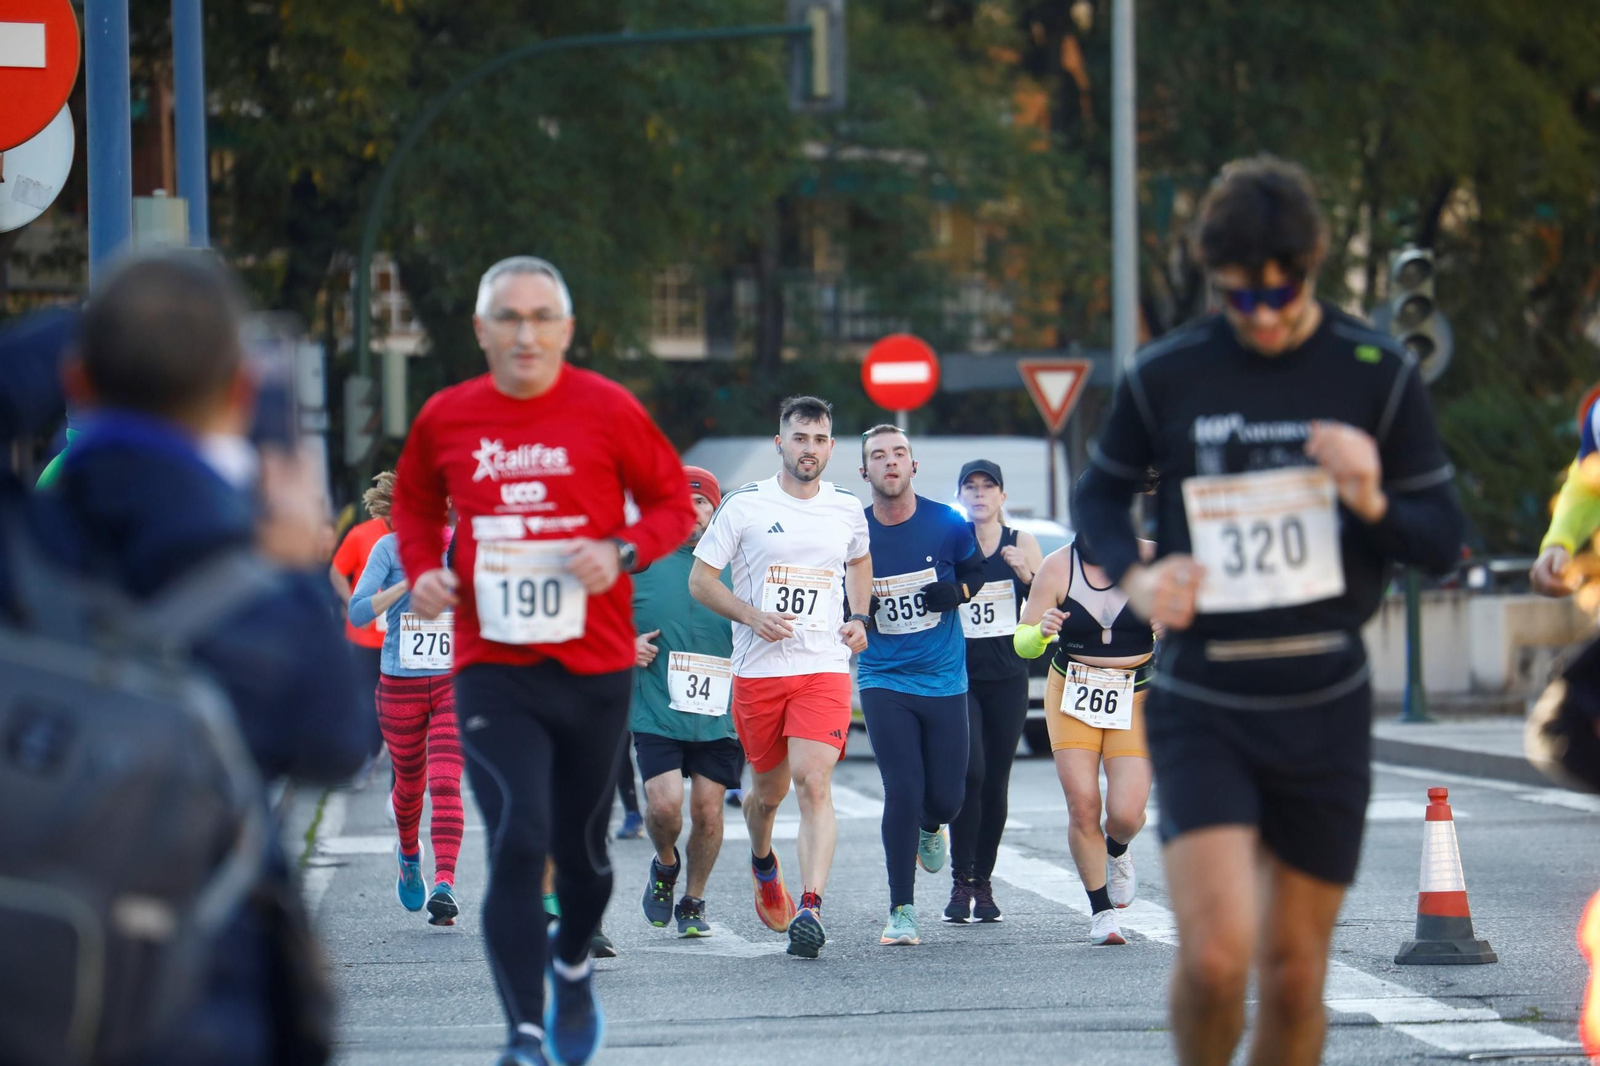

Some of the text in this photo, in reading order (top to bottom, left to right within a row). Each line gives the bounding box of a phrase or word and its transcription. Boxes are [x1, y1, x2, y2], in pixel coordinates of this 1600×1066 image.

[1220, 514, 1308, 578] 320
[767, 565, 789, 585] XLI
[499, 578, 561, 618] 190
[776, 586, 818, 615] 367
[884, 593, 928, 622] 359
[970, 602, 995, 625] 35
[413, 632, 451, 656] 276
[670, 653, 691, 672] XLI
[686, 674, 711, 701] 34
[1074, 686, 1119, 714] 266
